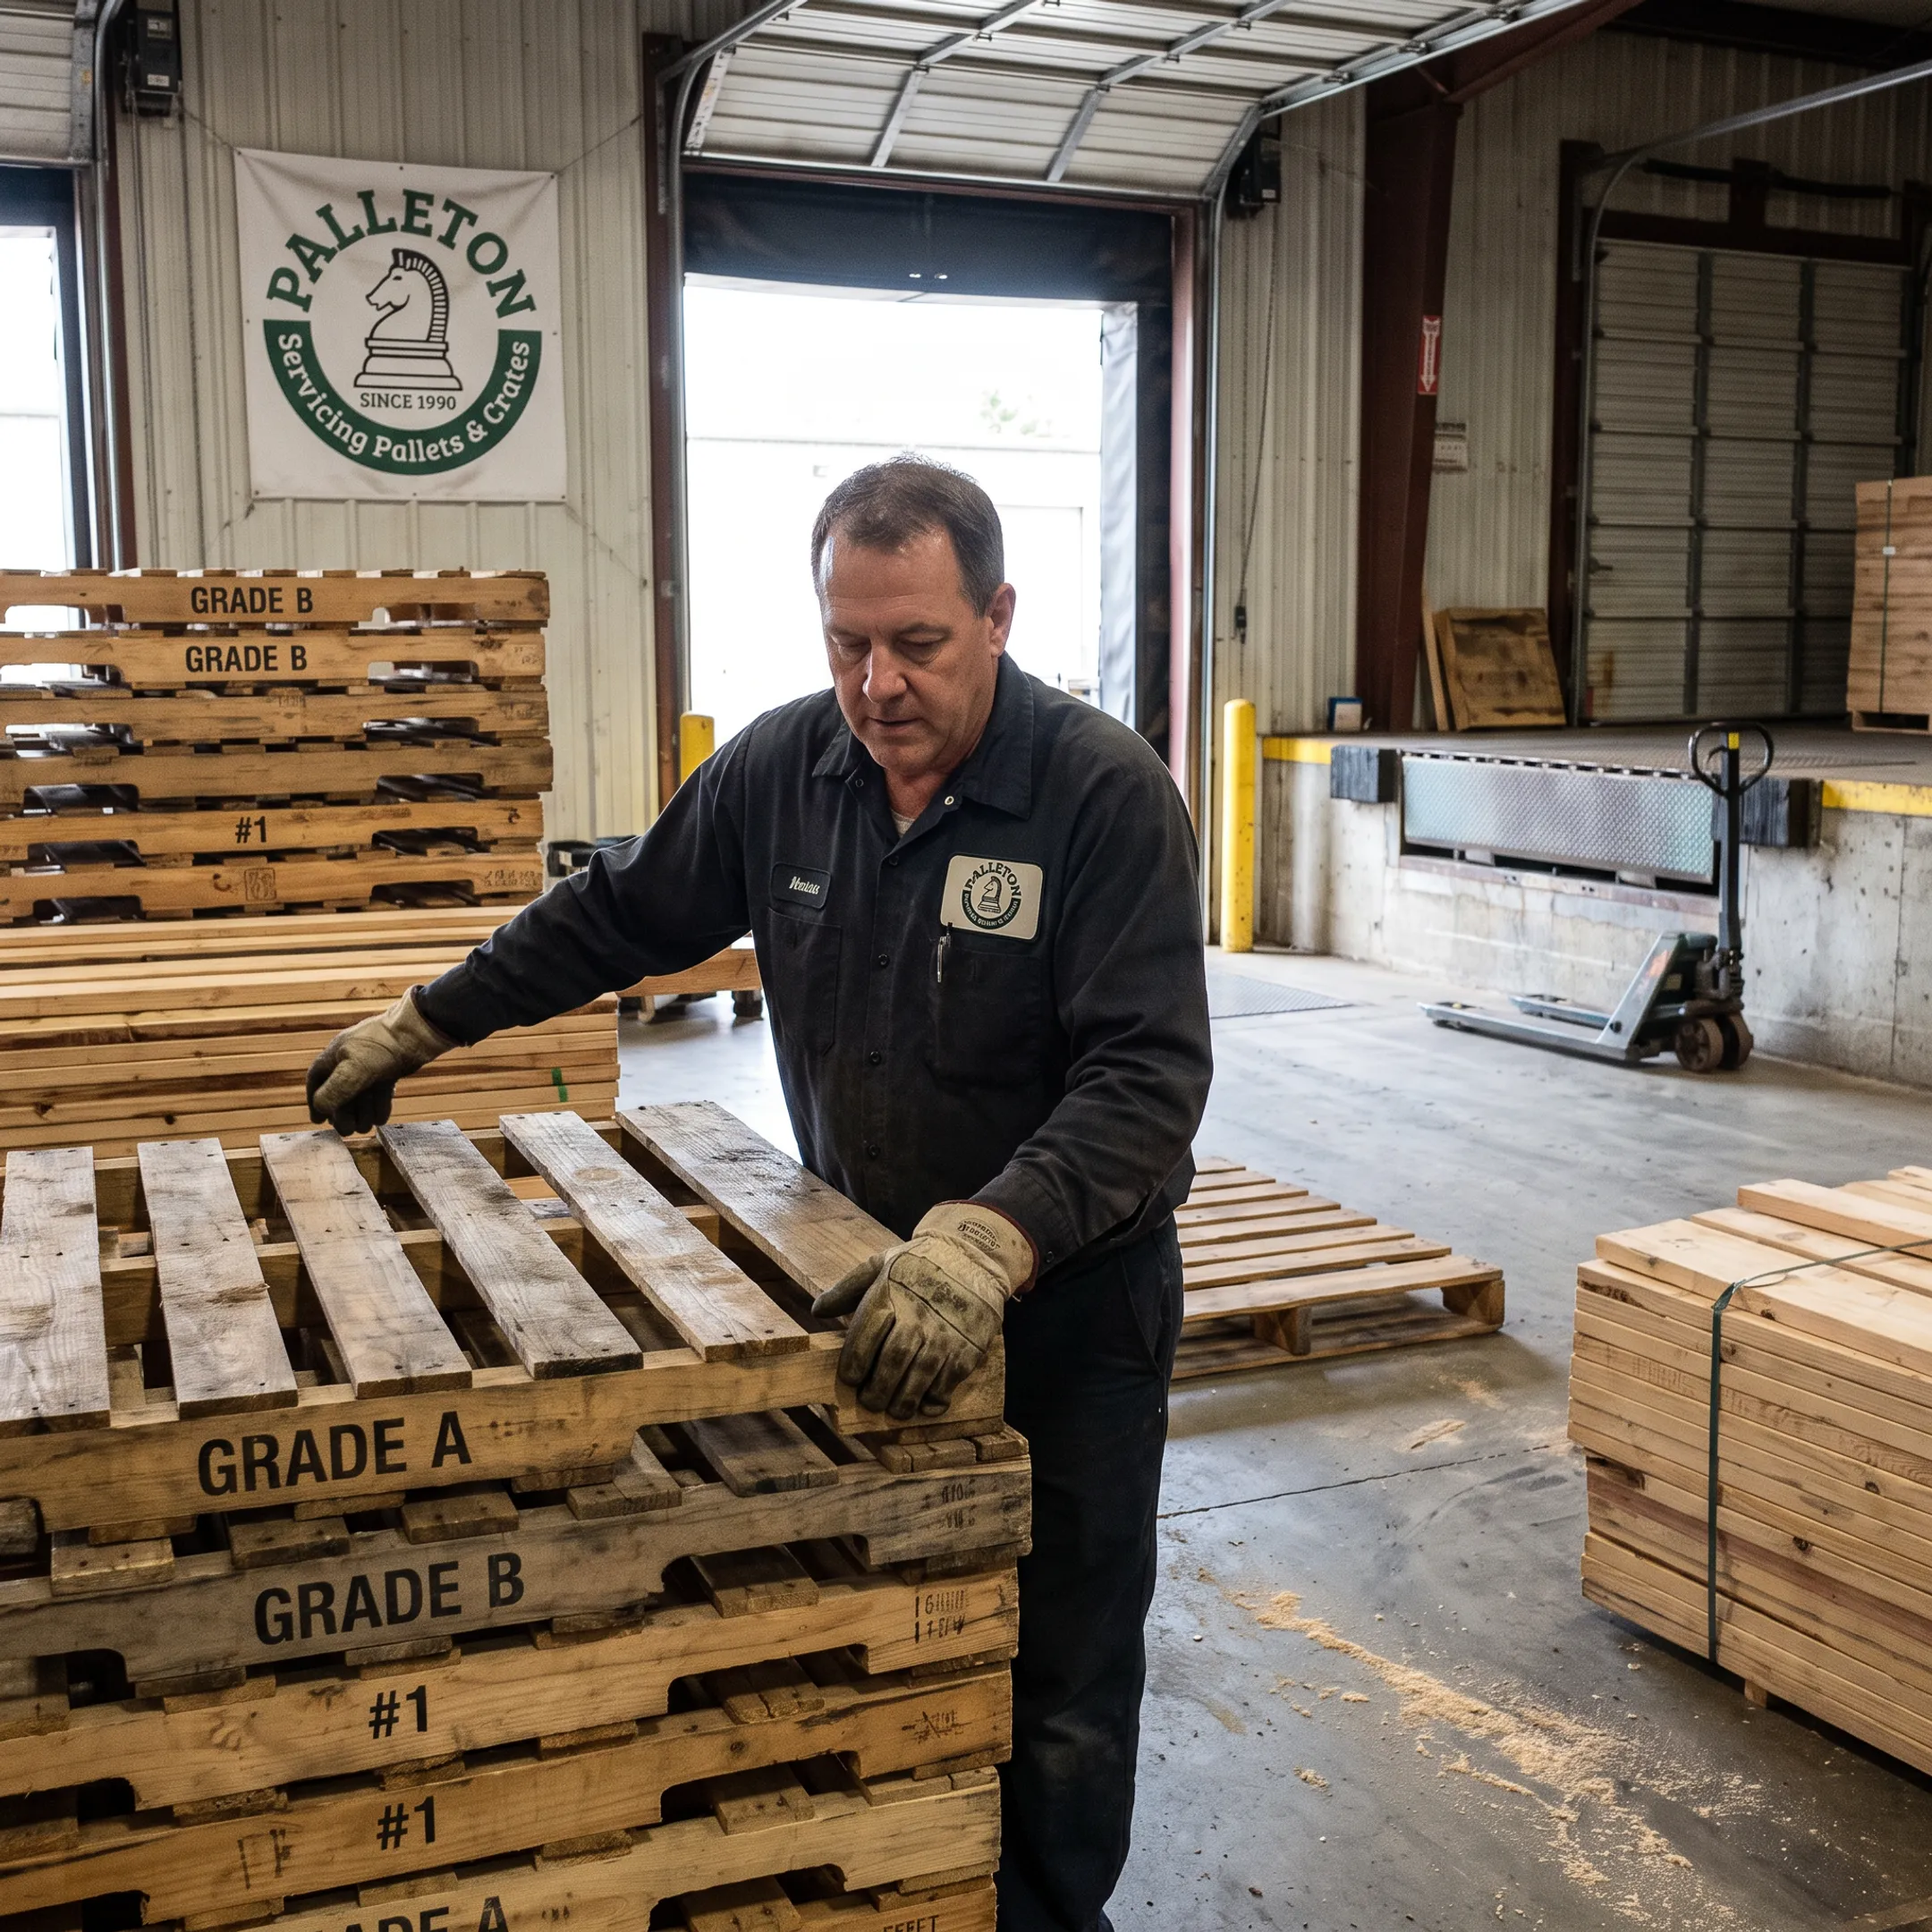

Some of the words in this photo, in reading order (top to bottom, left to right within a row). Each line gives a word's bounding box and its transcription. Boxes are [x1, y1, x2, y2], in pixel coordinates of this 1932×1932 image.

[266, 188, 537, 319] PALLETON
[277, 333, 369, 455] Servicing
[372, 434, 465, 463] Pallets
[465, 419, 488, 443] &
[482, 341, 530, 425] Crates
[360, 393, 412, 410] SINCE
[417, 395, 457, 410] 1990
[191, 586, 284, 614] GRADE
[296, 587, 313, 614] B
[185, 645, 278, 673] GRADE
[291, 645, 308, 671] B
[234, 816, 267, 843] #1
[198, 1417, 407, 1496] GRADE
[431, 1411, 472, 1469] A
[254, 1560, 462, 1646] GRADE
[487, 1552, 524, 1608] B
[369, 1685, 428, 1740] #1
[376, 1795, 436, 1851] #1
